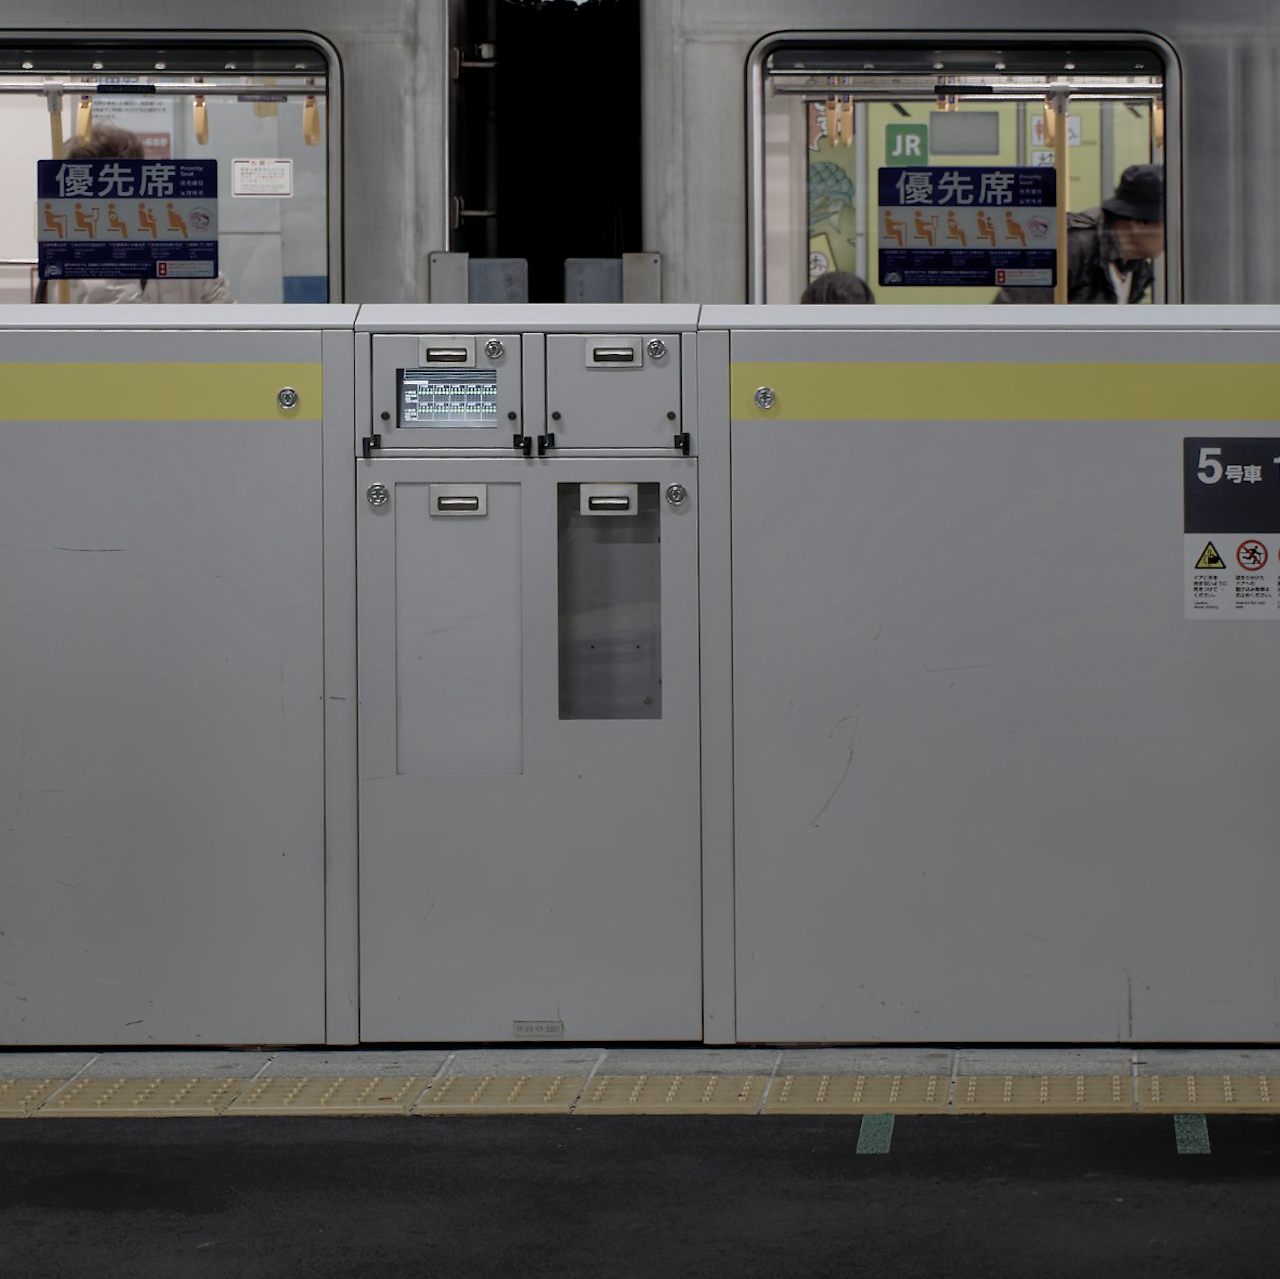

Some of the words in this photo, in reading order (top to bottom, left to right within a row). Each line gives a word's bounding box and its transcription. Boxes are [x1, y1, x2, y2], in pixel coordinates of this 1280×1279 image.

[891, 134, 922, 157] JR
[55, 163, 177, 198] 優先席
[895, 170, 1015, 205] 優先席
[1196, 447, 1263, 485] 5号車
